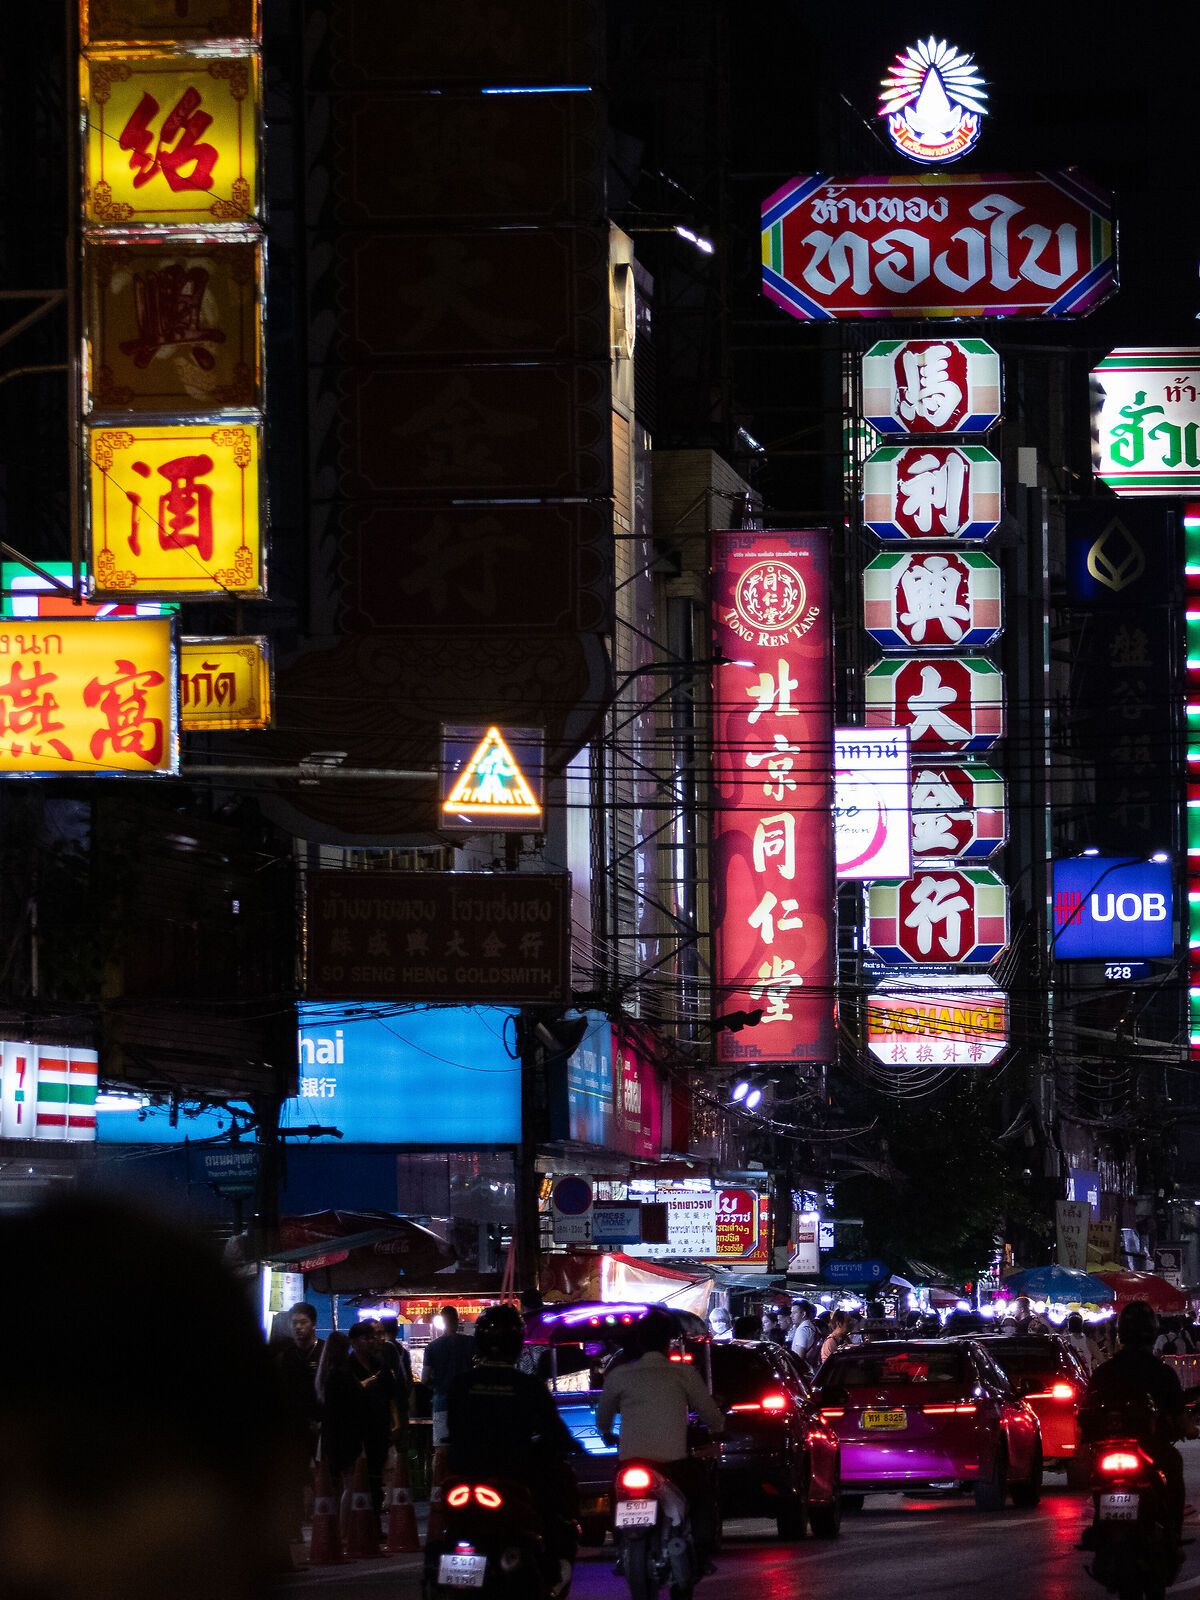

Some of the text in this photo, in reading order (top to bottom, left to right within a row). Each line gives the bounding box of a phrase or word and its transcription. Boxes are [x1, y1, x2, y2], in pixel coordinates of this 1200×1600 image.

[811, 187, 949, 223] ห้างทอง
[745, 657, 804, 1024] 北京同仁堂
[1089, 892, 1168, 922] UOB
[322, 967, 552, 984] SO SENG HENG GOLDSMITH
[1104, 966, 1132, 979] 428
[869, 1007, 1004, 1034] EXCHANGE
[298, 1076, 337, 1098] 银行
[602, 1218, 632, 1226] MONEY
[872, 1264, 880, 1276] 9
